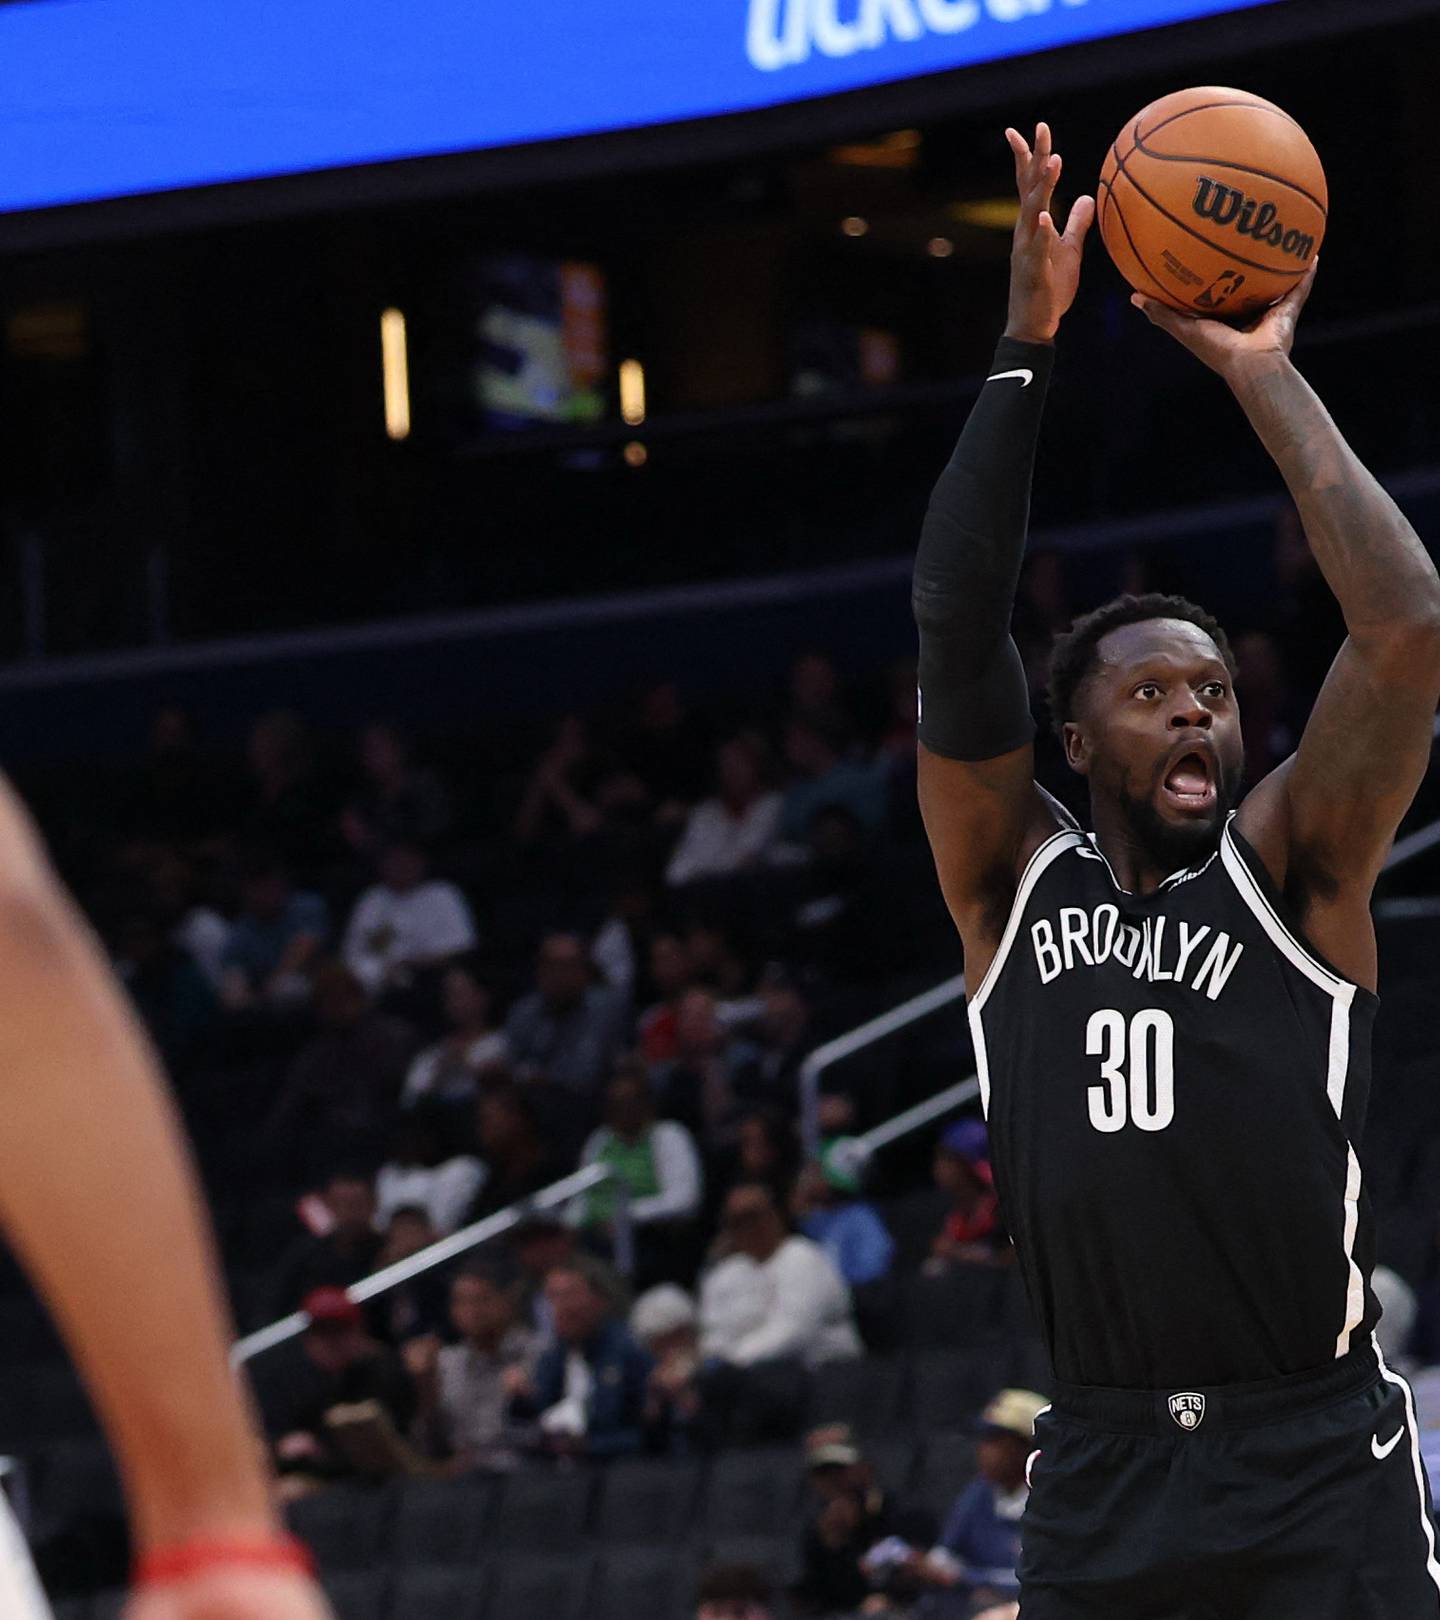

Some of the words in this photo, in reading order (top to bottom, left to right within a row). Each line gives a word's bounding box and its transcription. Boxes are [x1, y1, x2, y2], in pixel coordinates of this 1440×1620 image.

[1192, 176, 1314, 261] Wilson
[1031, 903, 1244, 1001] BROOKLYN
[1085, 1008, 1175, 1133] 30
[1172, 1396, 1202, 1413] NETS
